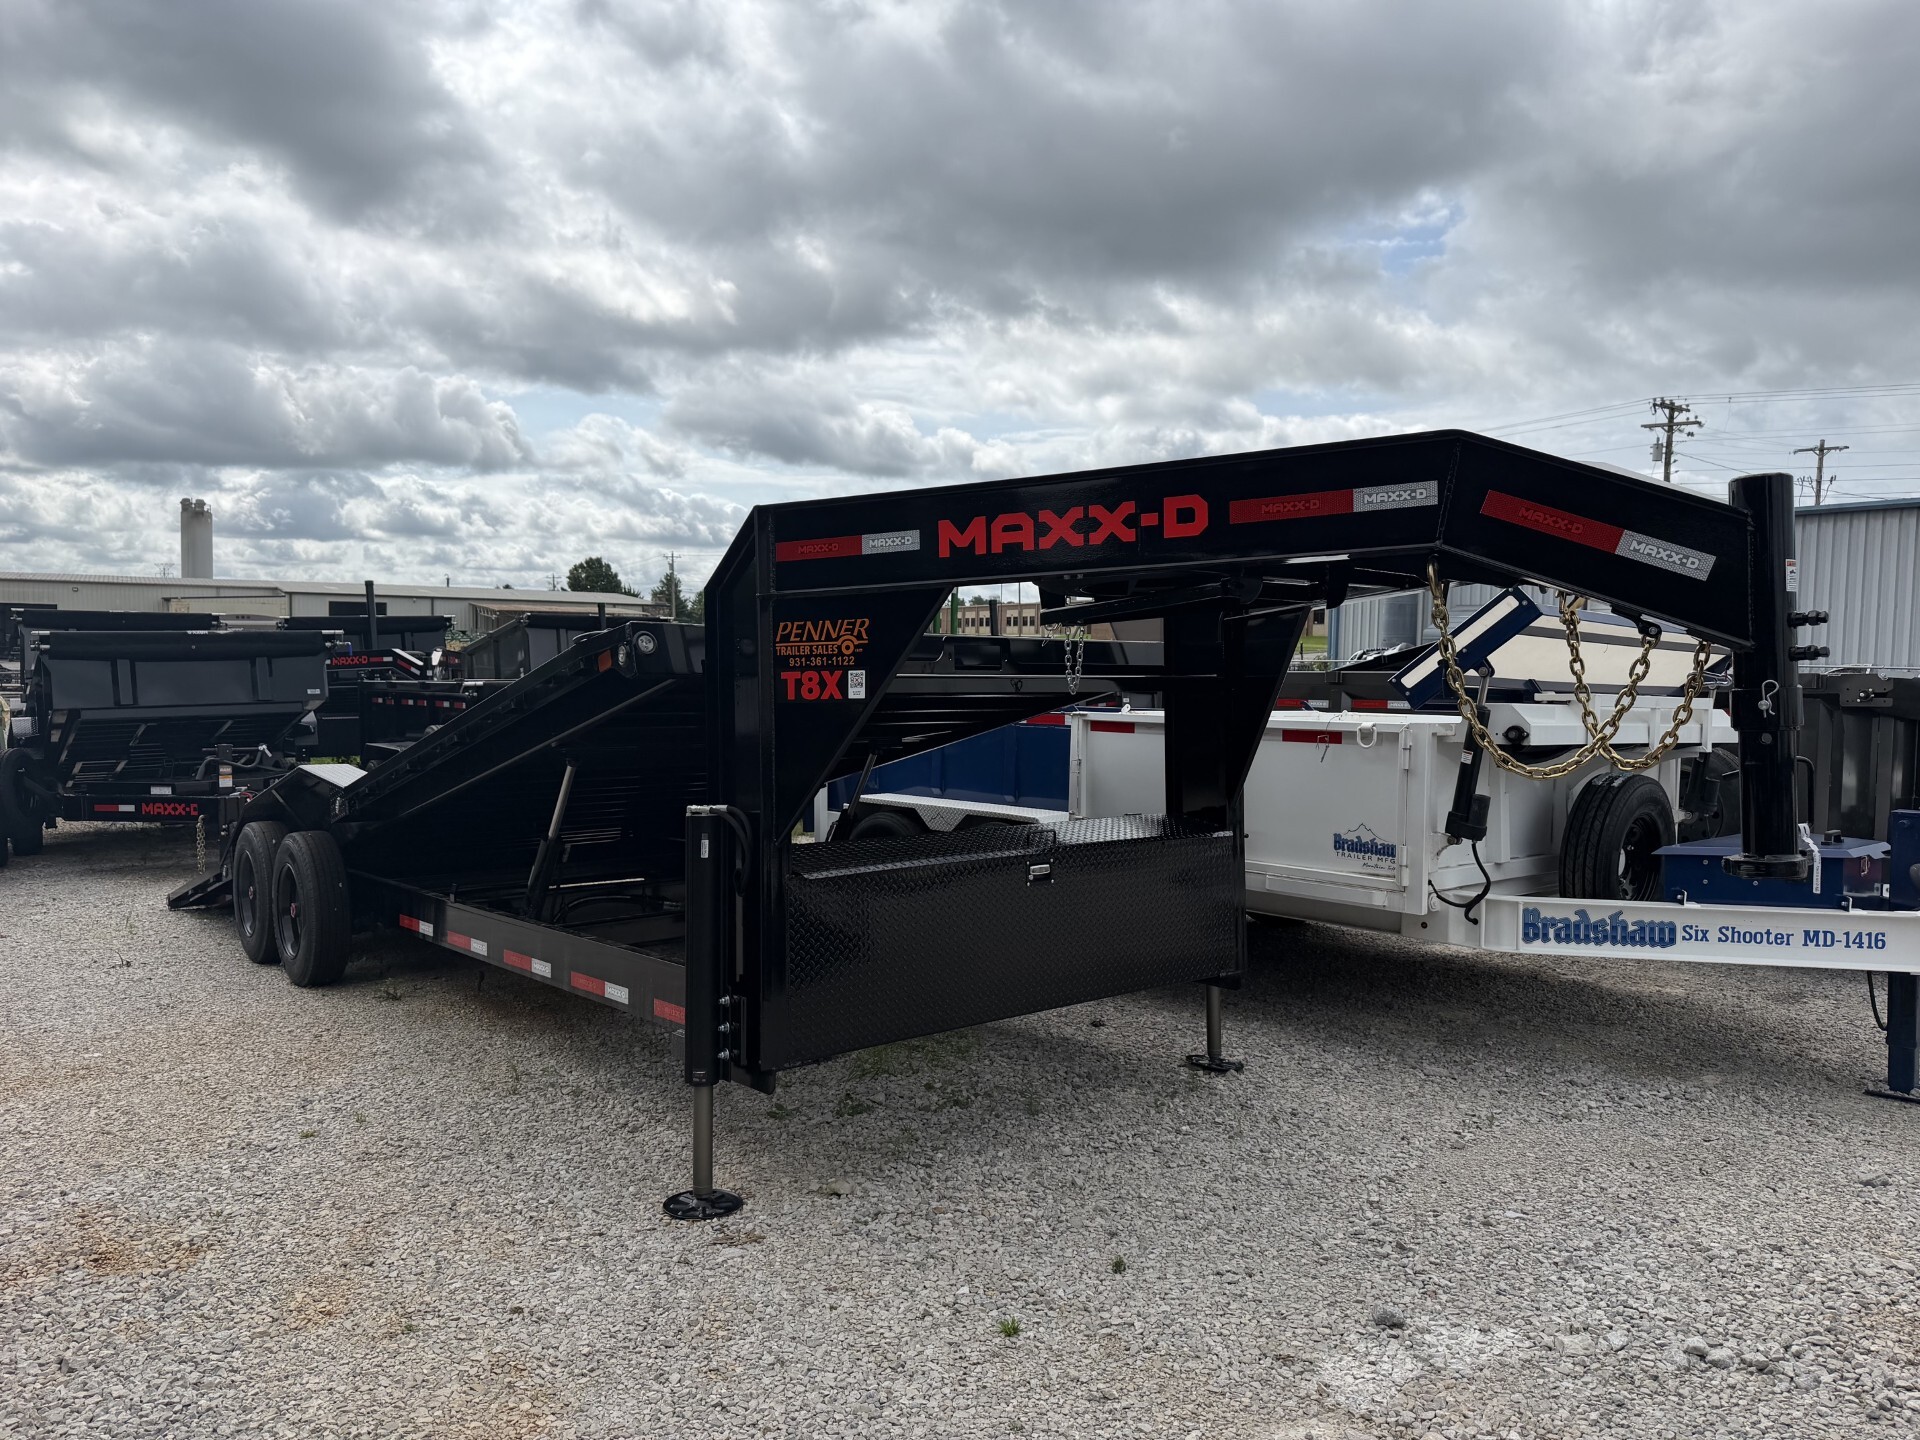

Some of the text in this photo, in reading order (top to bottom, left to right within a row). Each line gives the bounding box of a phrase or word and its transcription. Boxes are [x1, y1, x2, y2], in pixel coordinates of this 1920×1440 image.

[1261, 498, 1320, 514] MAXX-D
[1366, 488, 1427, 504] MAXX-D
[938, 493, 1209, 558] MAXX-D
[1518, 506, 1585, 535] MAXX-D
[798, 543, 839, 554] MAXX-D
[868, 536, 913, 549] MAXX-D
[1629, 538, 1701, 570] MAXX-D
[775, 618, 870, 642] PENNER
[776, 644, 839, 656] TRAILER SALES
[332, 655, 368, 666] MAXX-D
[789, 656, 855, 667] 931-361-1122
[780, 670, 843, 700] T8X
[1333, 833, 1397, 858] Bradshaw
[1336, 851, 1396, 865] TRAILER MFG
[1522, 907, 1677, 949] Bradshaw
[1681, 924, 1887, 950] Six Shooter MD-1416
